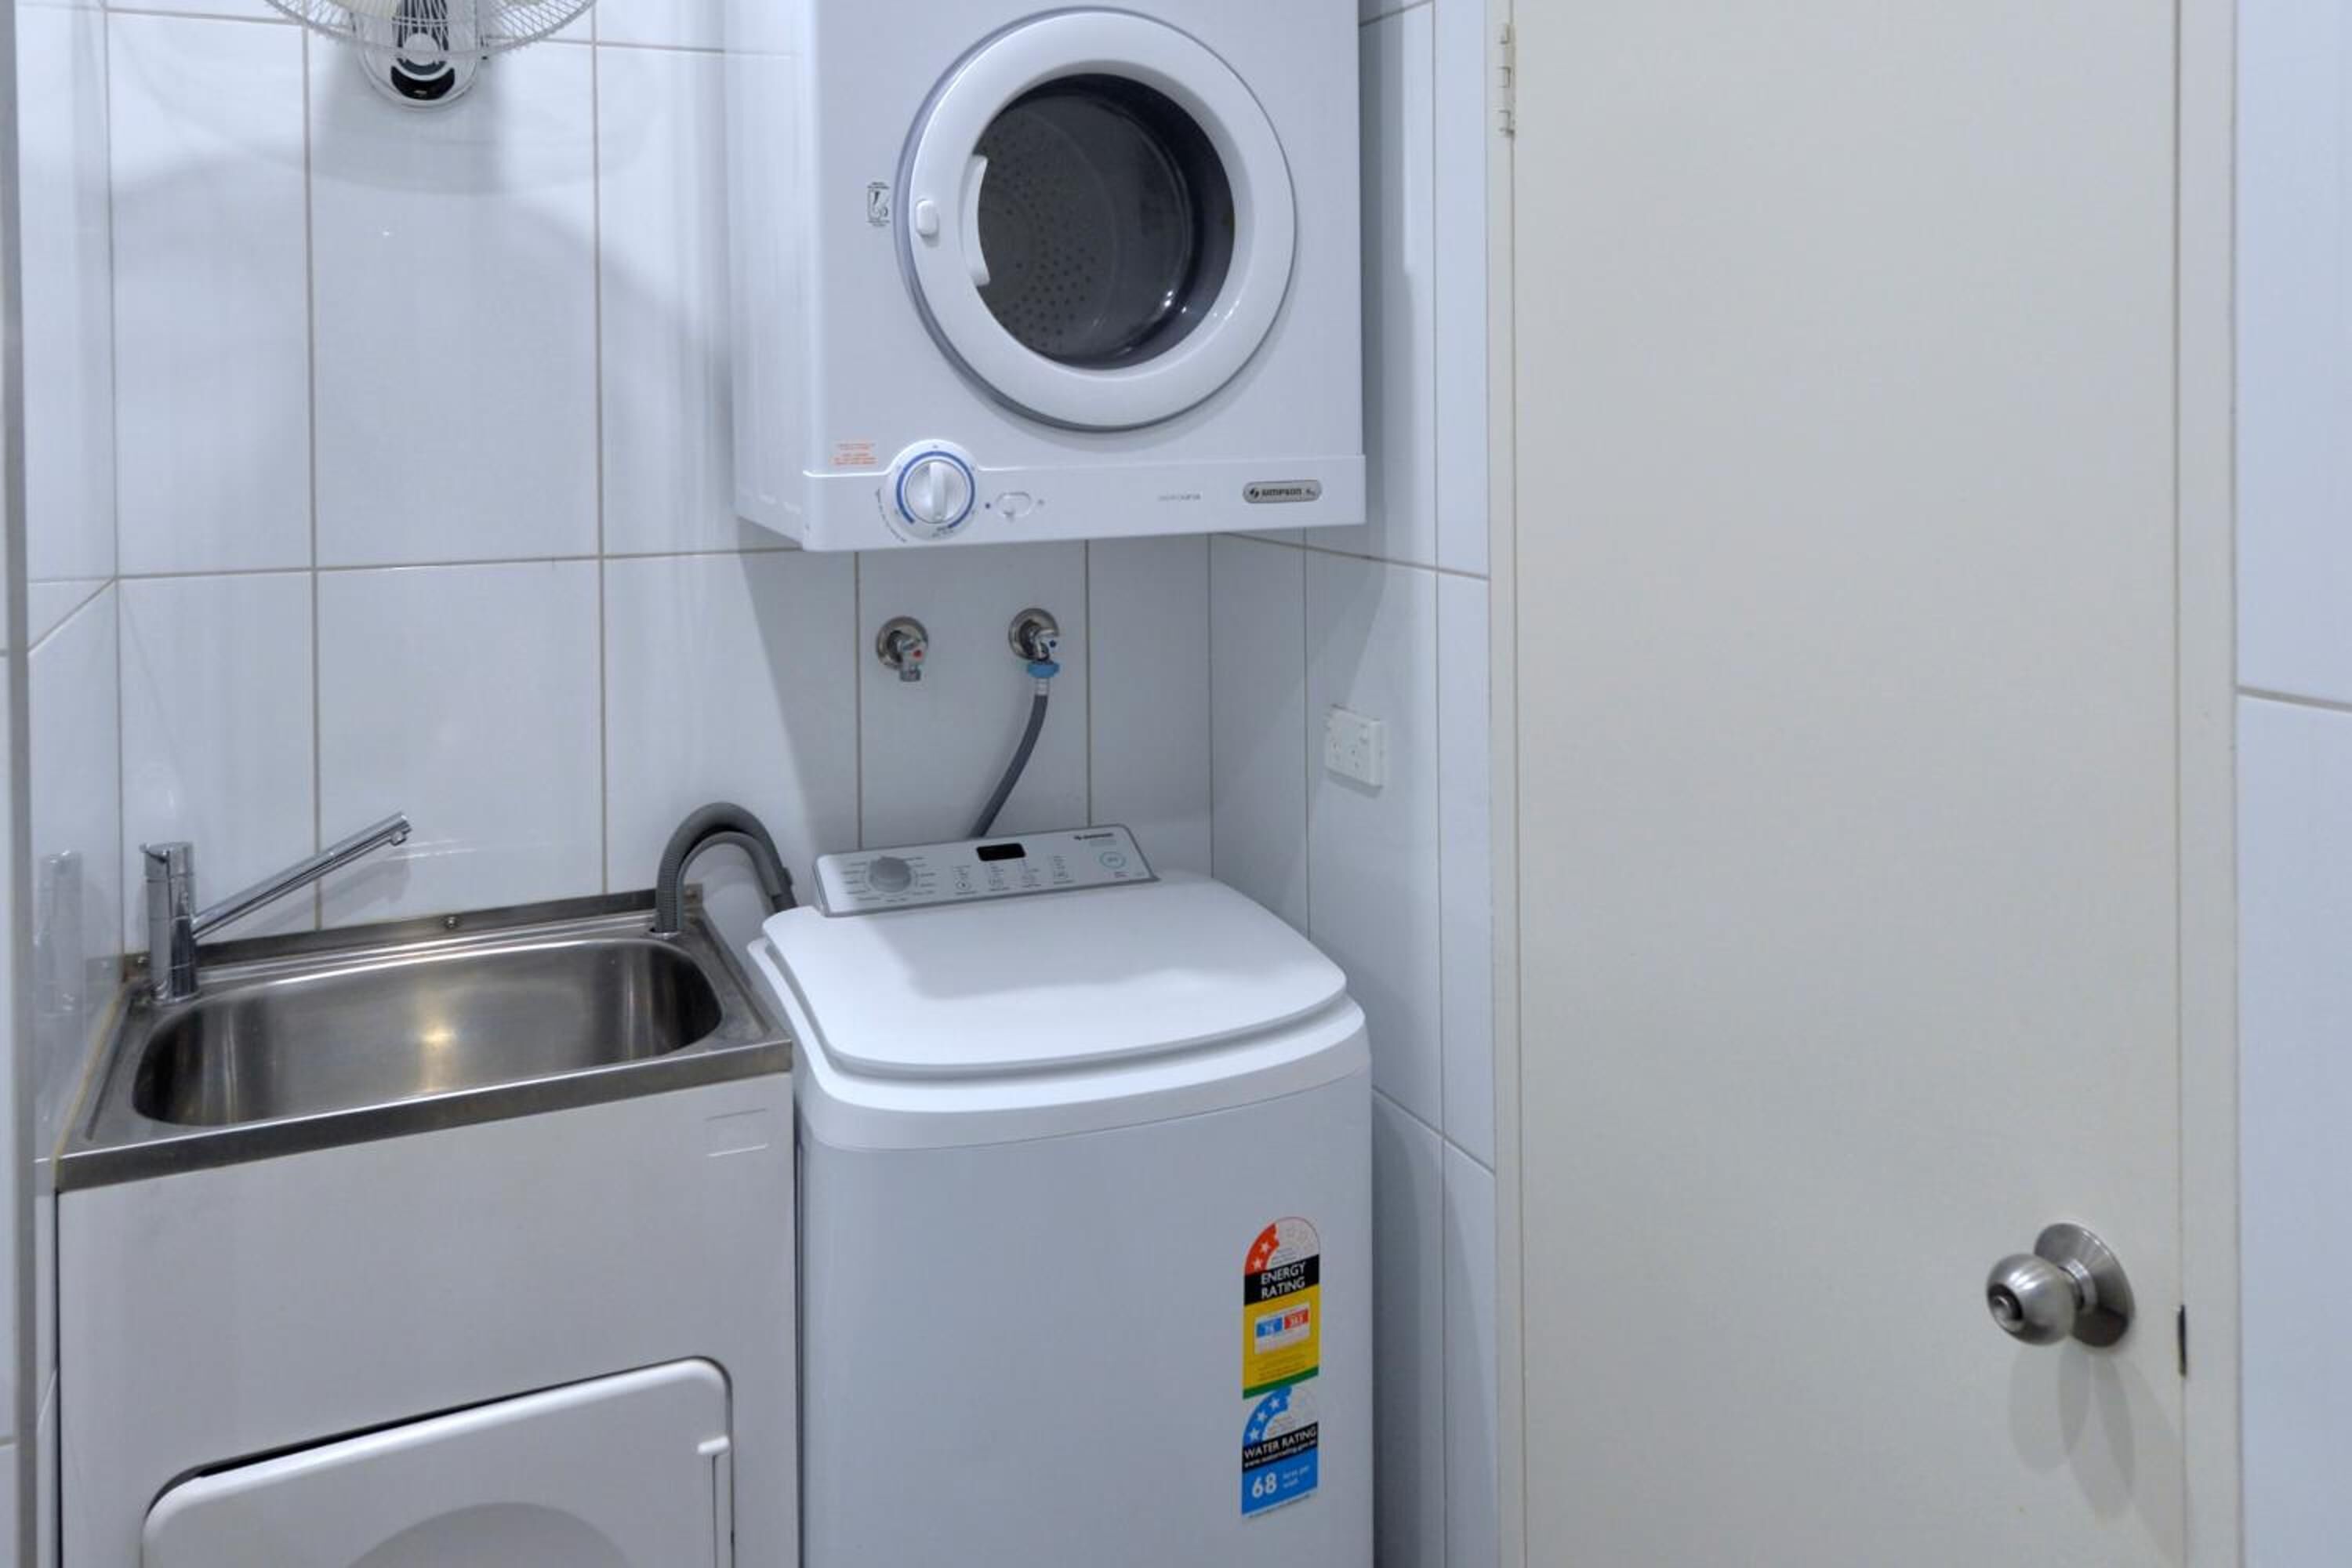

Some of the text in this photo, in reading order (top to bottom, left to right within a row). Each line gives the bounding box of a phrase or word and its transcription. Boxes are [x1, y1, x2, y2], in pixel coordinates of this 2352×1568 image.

[1261, 1261, 1305, 1285] ENERGY
[1261, 1277, 1305, 1299] RATING
[1243, 1442, 1279, 1459] WATER
[1282, 1427, 1316, 1448] RATING
[1252, 1472, 1277, 1498] 68
